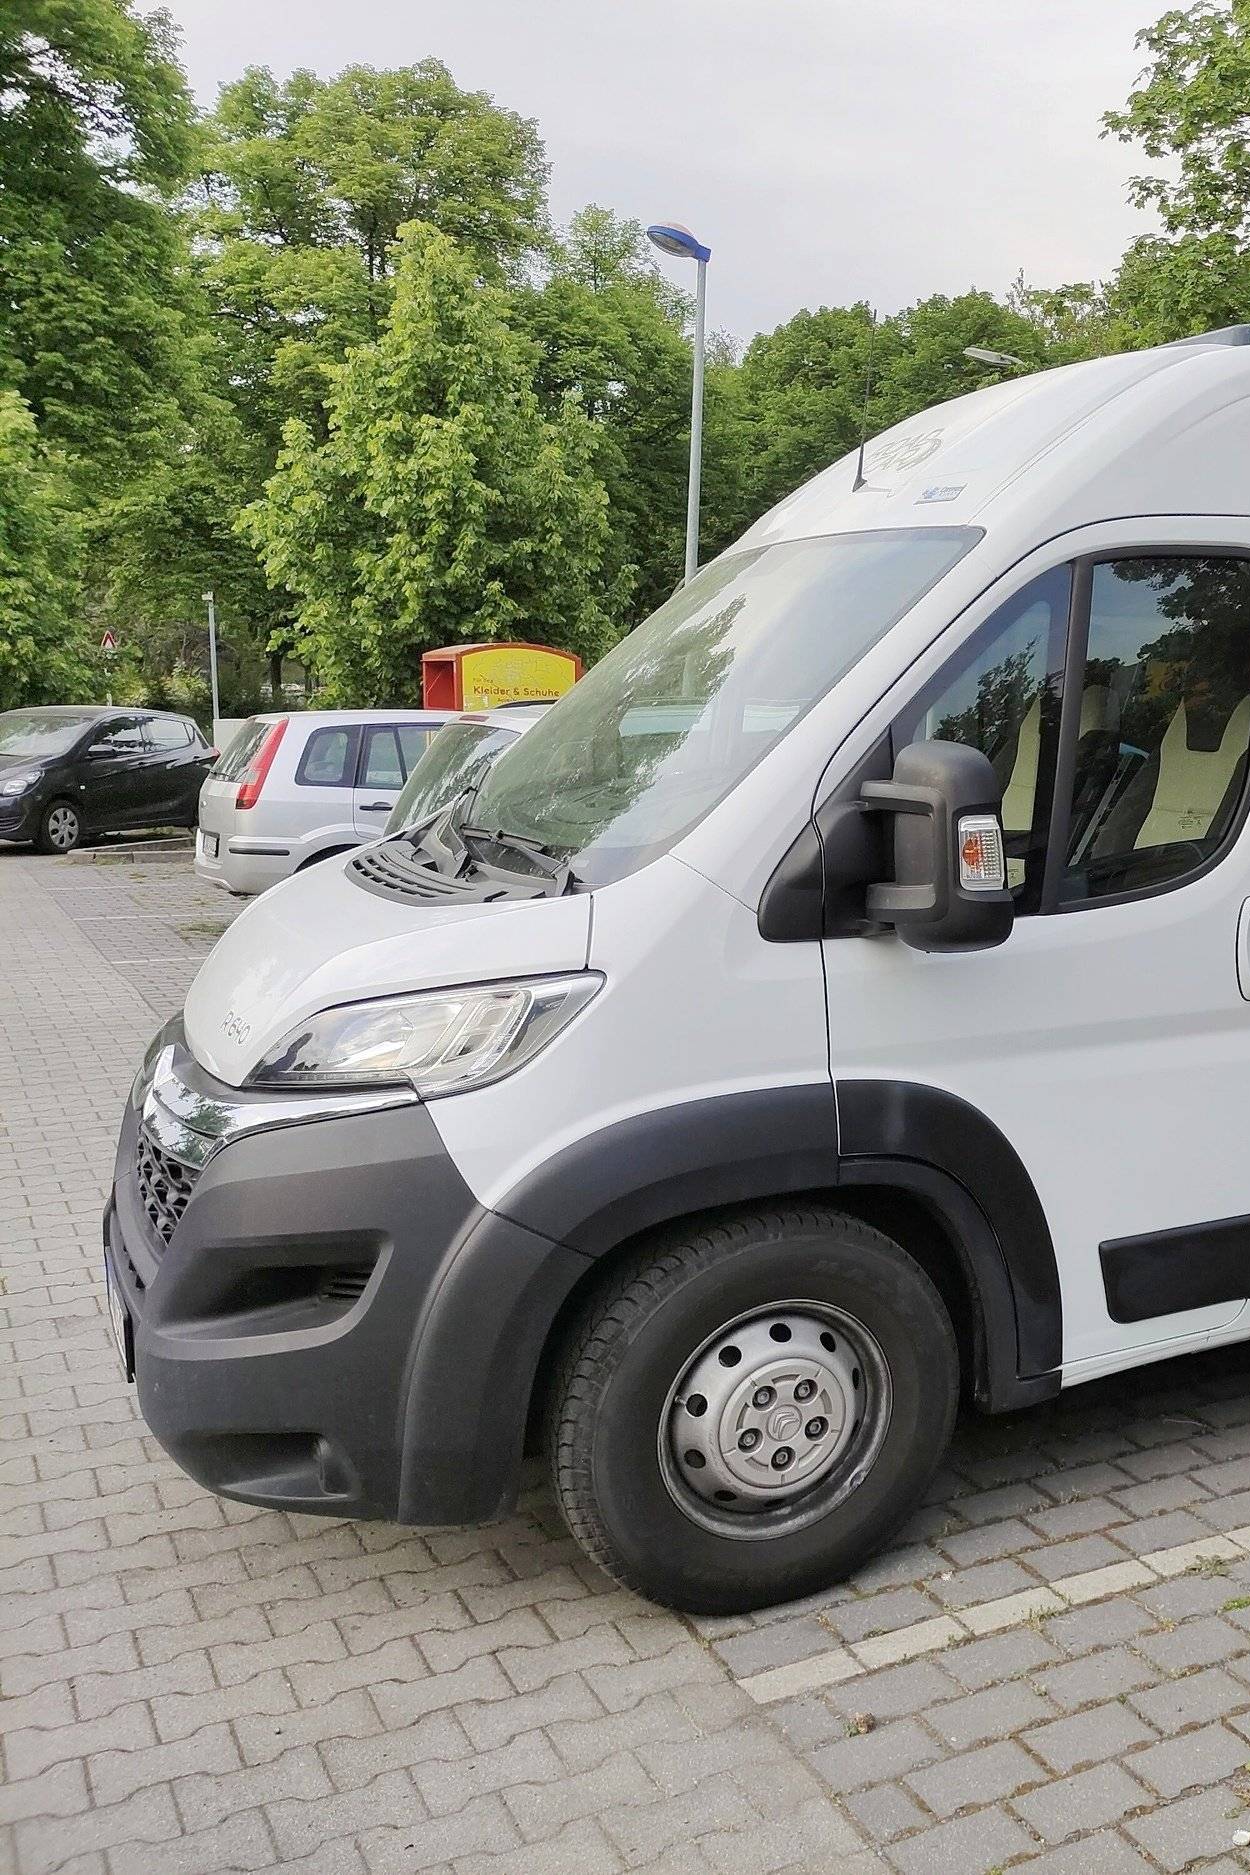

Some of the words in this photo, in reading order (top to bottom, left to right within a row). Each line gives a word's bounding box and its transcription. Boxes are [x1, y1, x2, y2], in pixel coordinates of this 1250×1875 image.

[473, 685, 510, 696] Kleider
[513, 687, 520, 696] &
[523, 687, 560, 697] Schuhe
